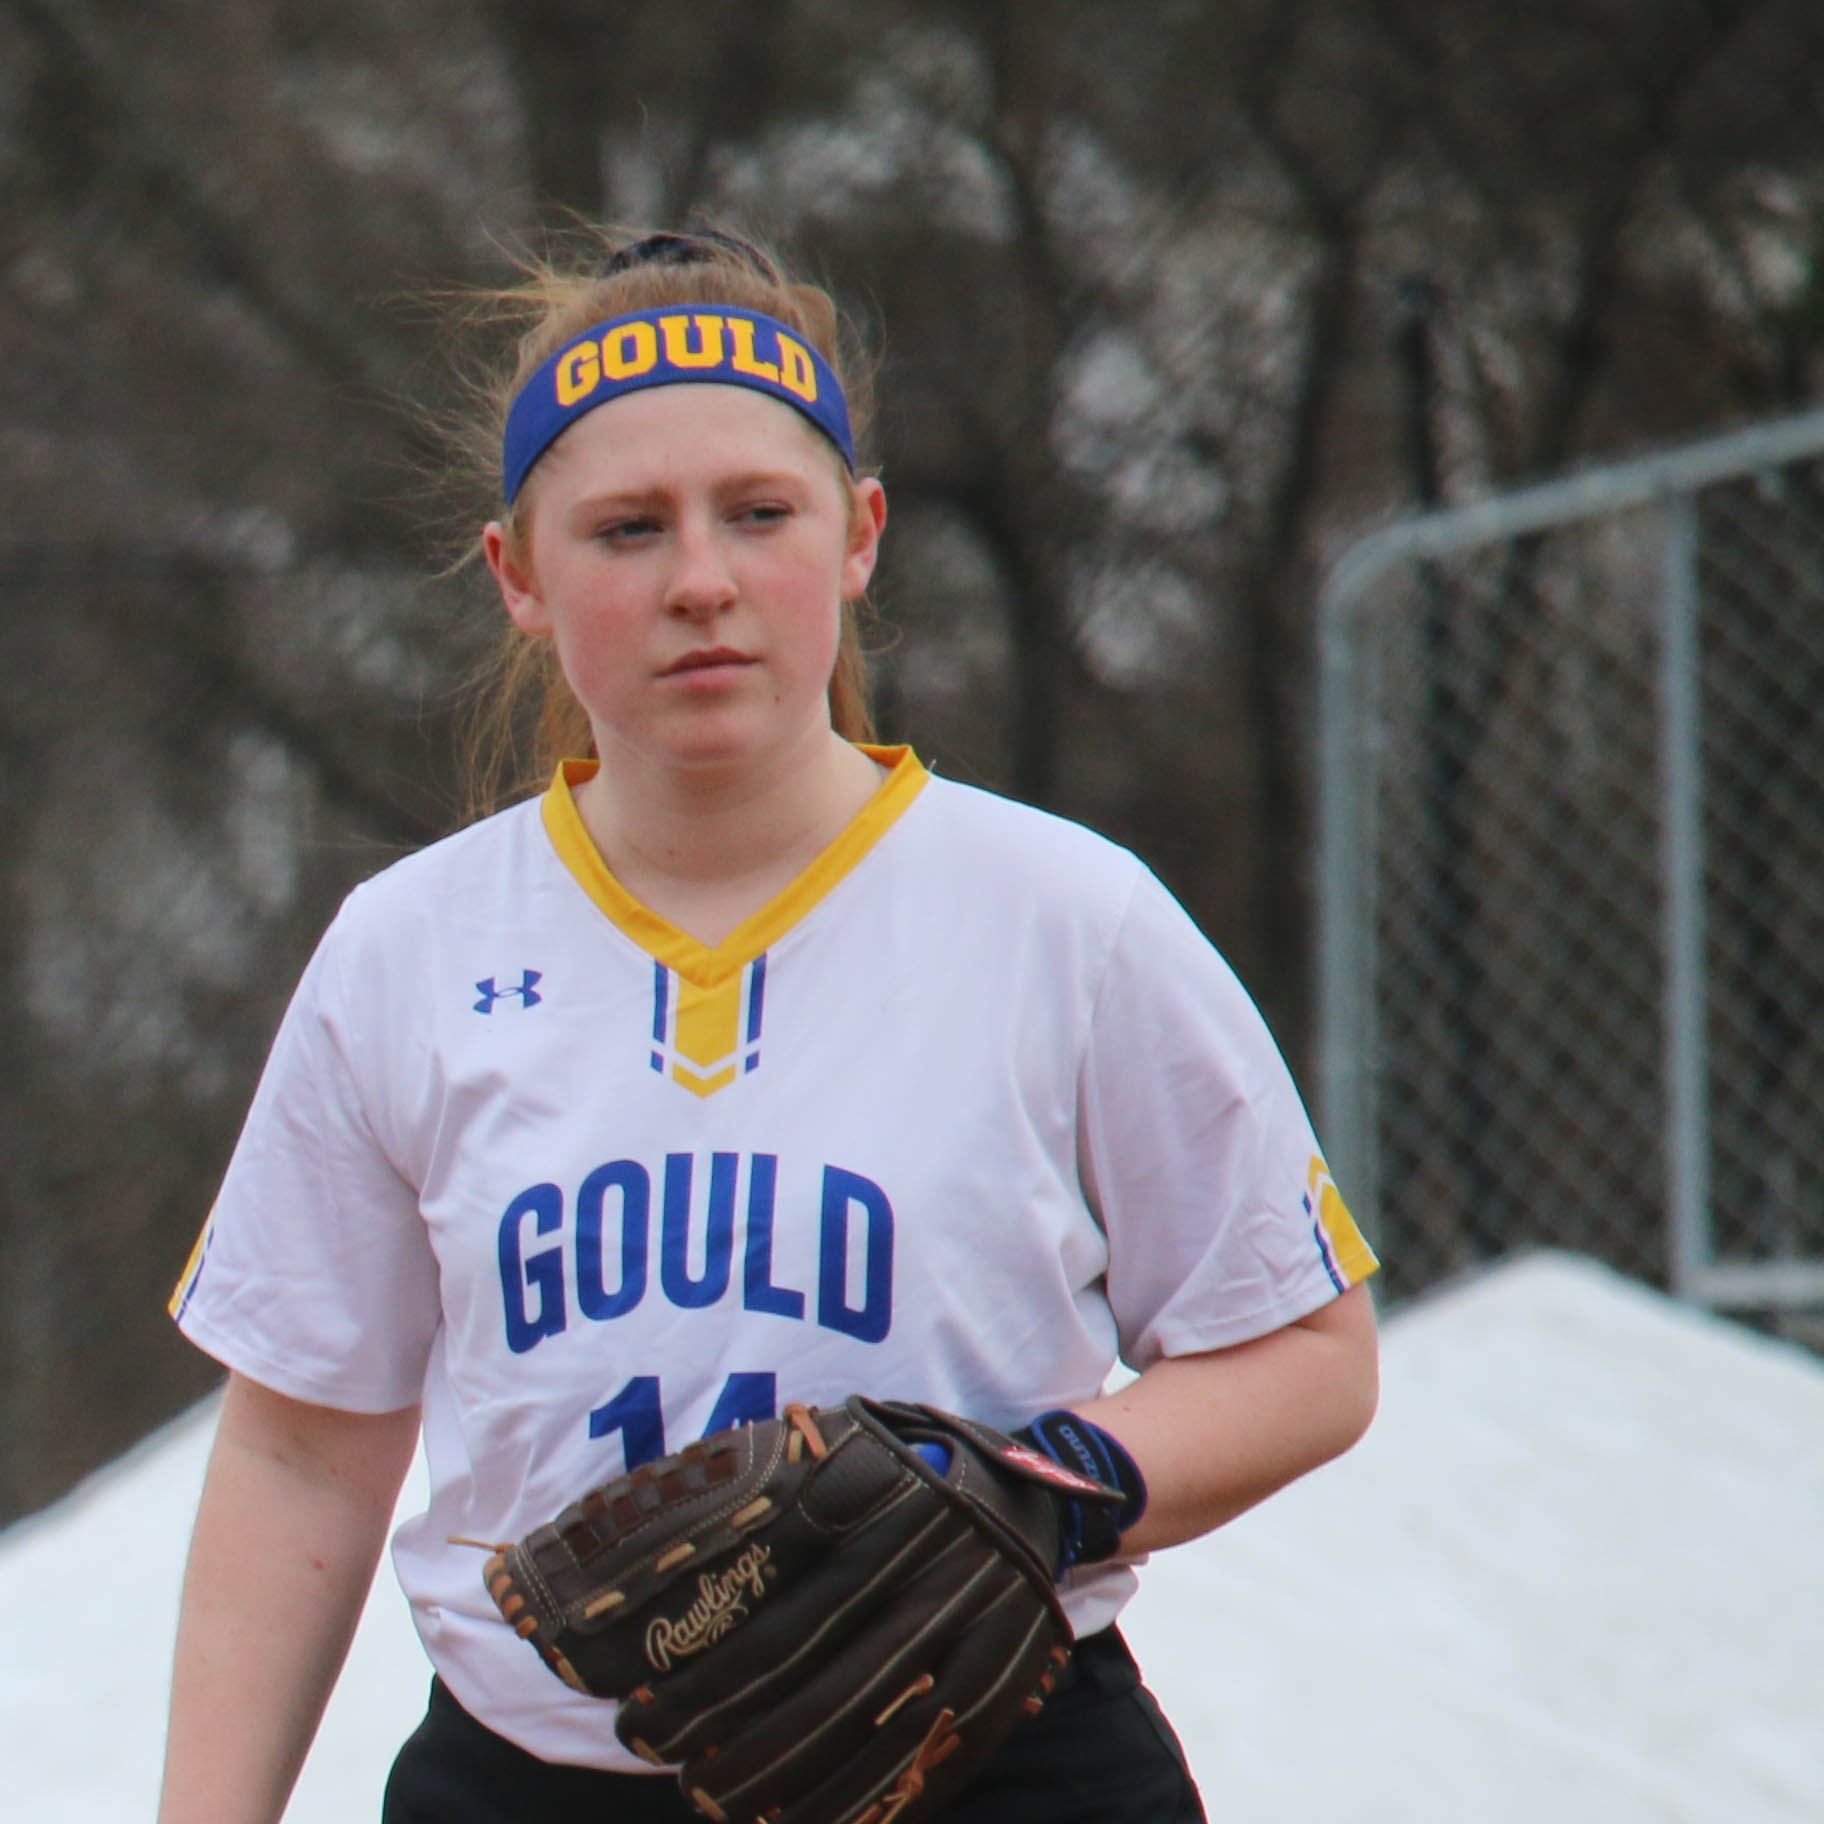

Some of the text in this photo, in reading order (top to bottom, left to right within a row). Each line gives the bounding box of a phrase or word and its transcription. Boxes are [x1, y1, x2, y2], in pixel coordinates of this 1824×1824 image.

[555, 314, 819, 408] GOULD
[497, 1151, 896, 1355] GOULD
[645, 1543, 771, 1672] Rawlings
